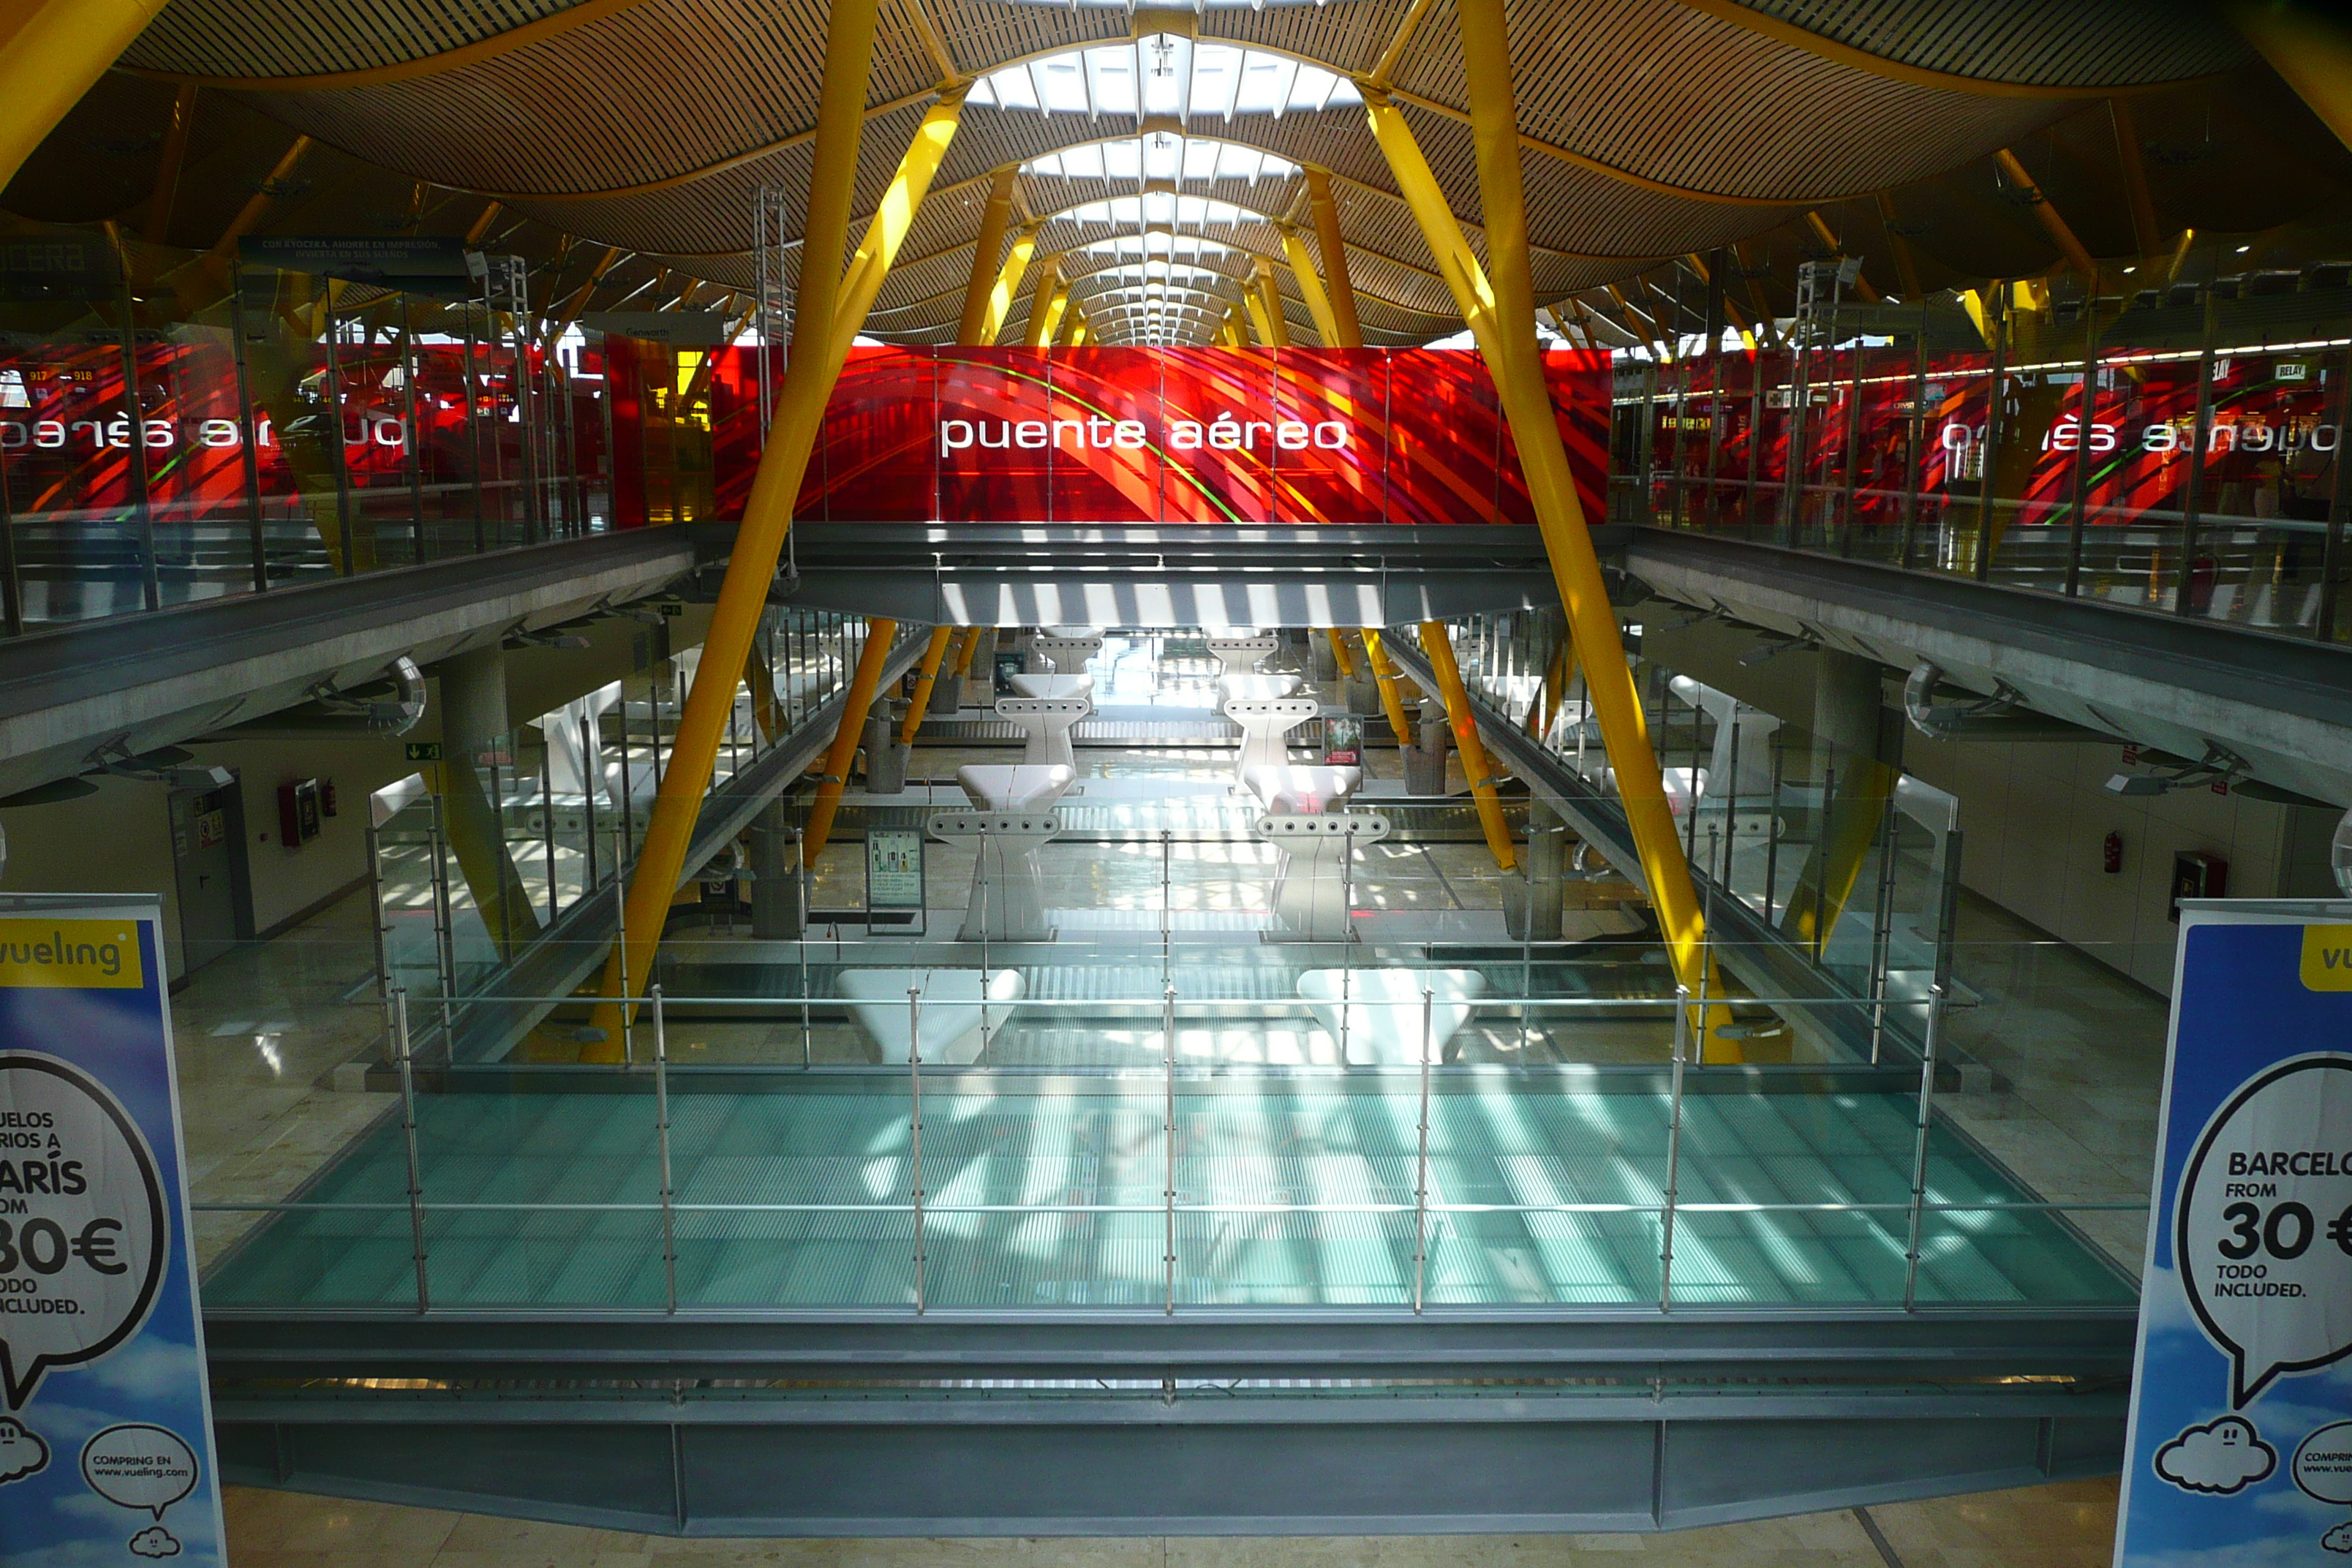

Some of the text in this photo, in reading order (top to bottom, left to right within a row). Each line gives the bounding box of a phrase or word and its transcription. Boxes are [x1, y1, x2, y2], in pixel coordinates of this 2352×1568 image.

[262, 239, 441, 250] CON KYOCERA, AHORRE EN IMPRESIÓN,
[295, 249, 409, 259] INVIERTA EN SUS SUEÑOS
[29, 371, 93, 381] 917 918
[2280, 366, 2303, 377] RELAY
[941, 411, 1348, 458] puente aéreo
[47, 1133, 61, 1148] A
[2225, 1183, 2277, 1197] FROM
[2217, 1202, 2315, 1260] 30
[2216, 1264, 2267, 1279] TODO
[2215, 1283, 2307, 1297] INCLUDED.
[93, 1456, 171, 1466] COMPRING EN
[94, 1467, 188, 1478] www.vueling.com
